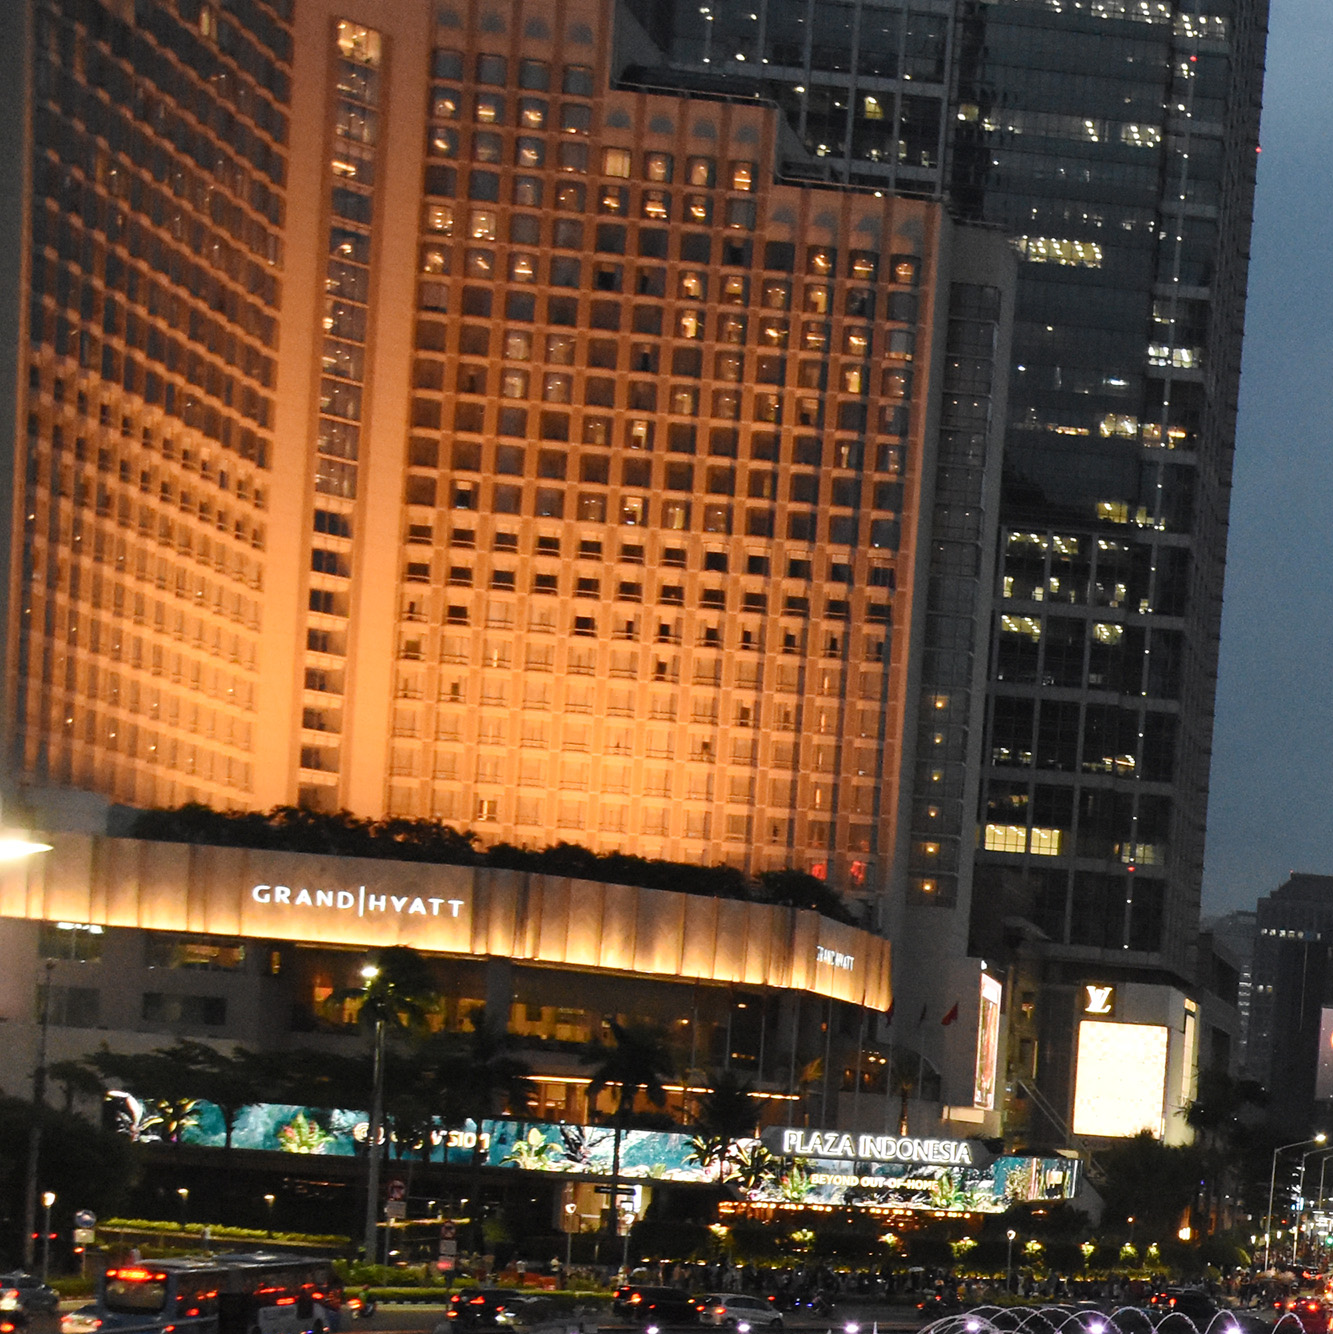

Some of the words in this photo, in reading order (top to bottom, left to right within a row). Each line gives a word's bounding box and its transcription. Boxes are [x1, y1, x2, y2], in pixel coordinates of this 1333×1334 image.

[252, 884, 354, 909] GRAND
[368, 893, 465, 918] HYATT
[783, 1129, 855, 1157] PLAZA
[858, 1134, 973, 1165] INDONESIA
[810, 1173, 859, 1188] BEYOND
